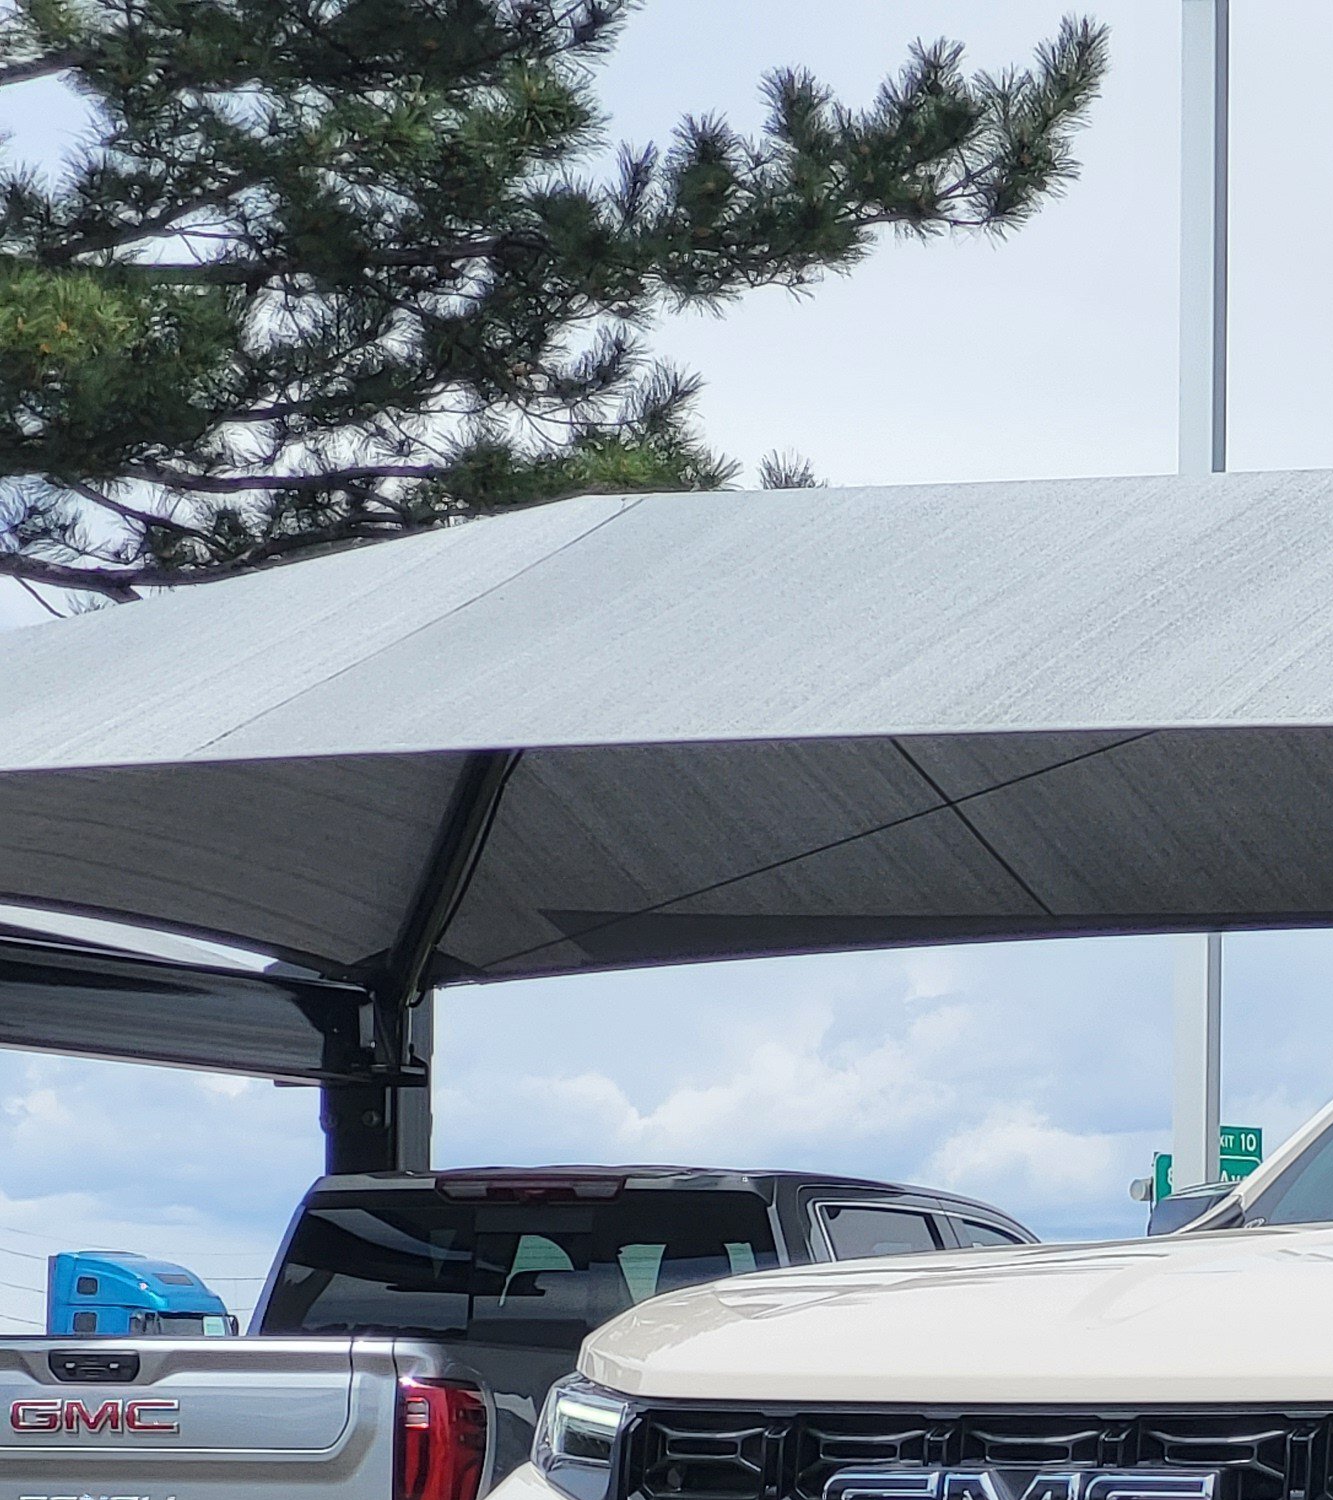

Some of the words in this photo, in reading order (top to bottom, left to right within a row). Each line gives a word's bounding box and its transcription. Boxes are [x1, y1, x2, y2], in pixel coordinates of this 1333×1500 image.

[1220, 1134, 1235, 1149] XIT
[1240, 1133, 1257, 1151] 10
[10, 1398, 181, 1434] GMC
